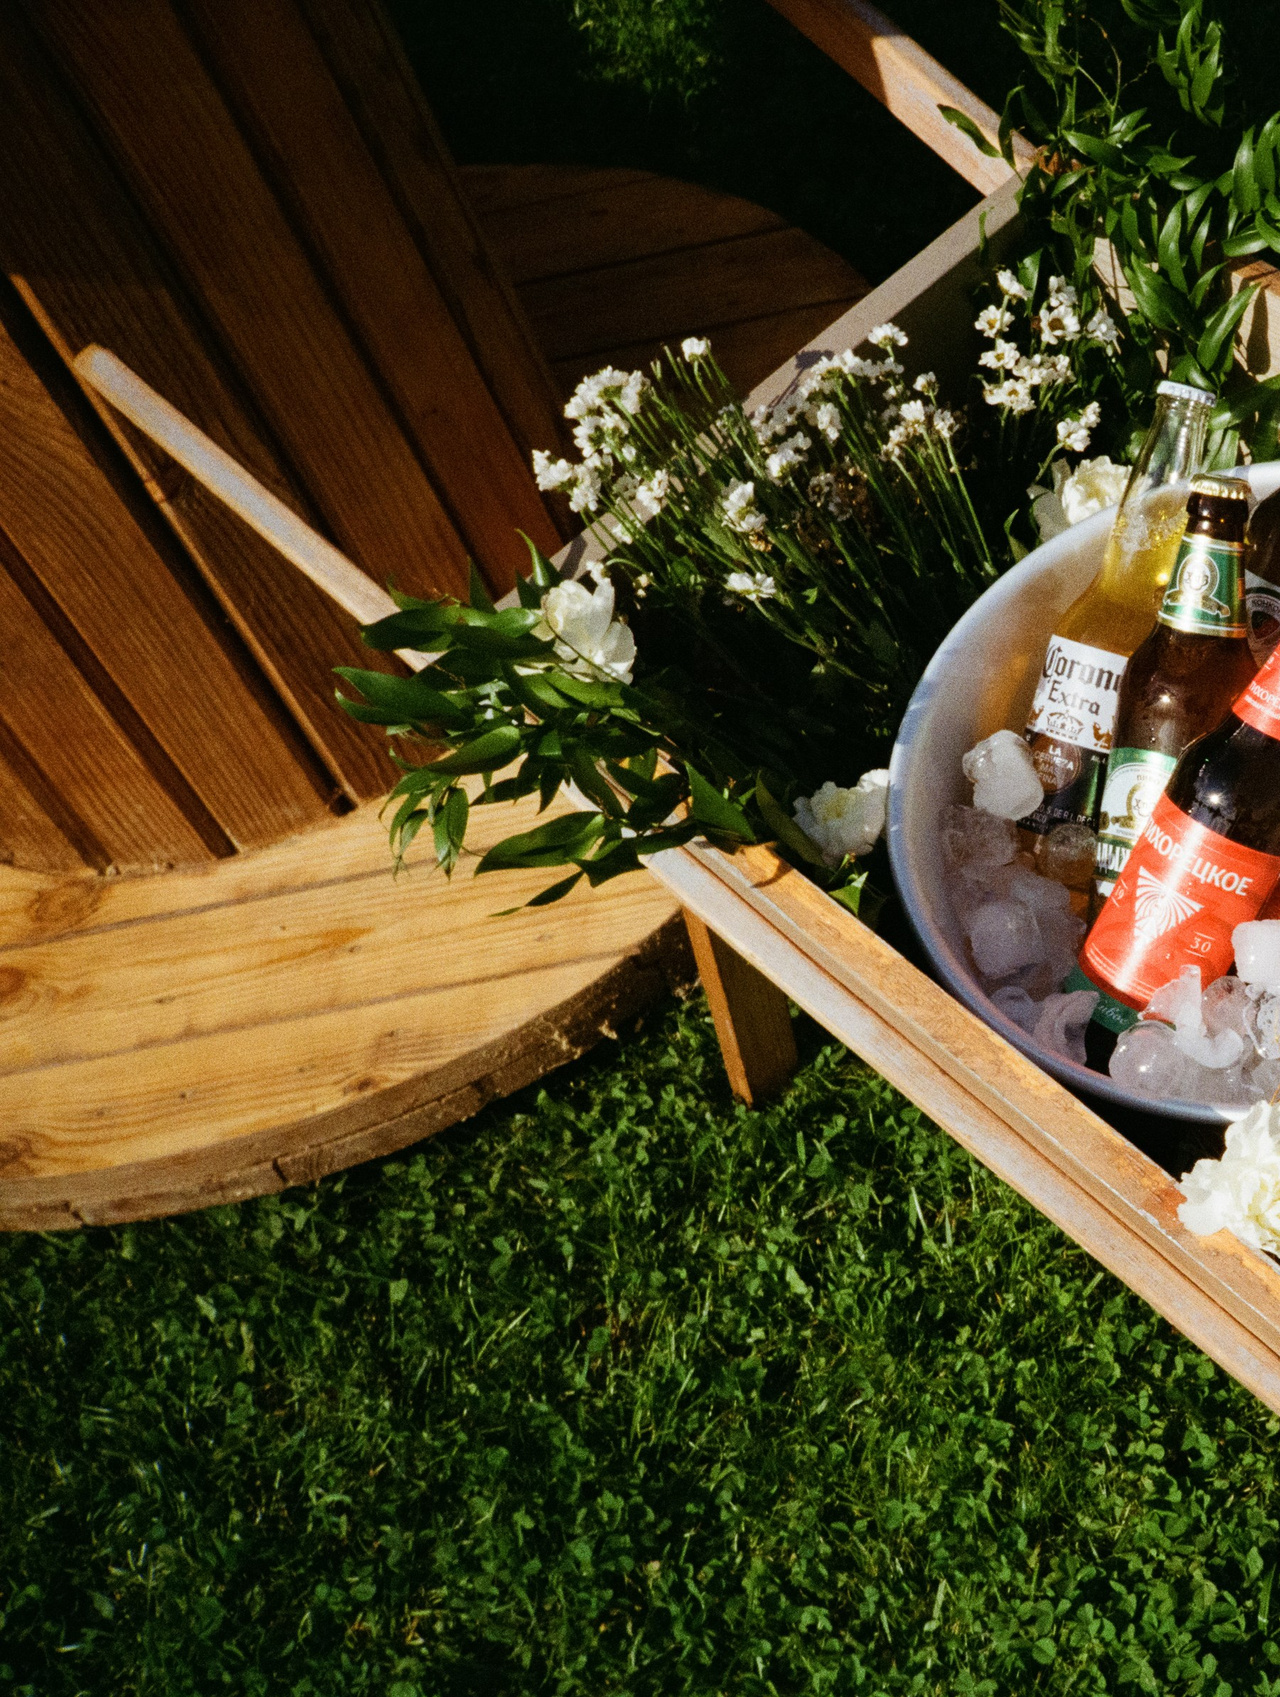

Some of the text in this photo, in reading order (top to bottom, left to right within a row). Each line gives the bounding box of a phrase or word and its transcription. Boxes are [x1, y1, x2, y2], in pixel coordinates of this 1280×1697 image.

[1047, 680, 1101, 716] Extra
[1048, 744, 1062, 757] LA
[1190, 937, 1212, 953] 30
